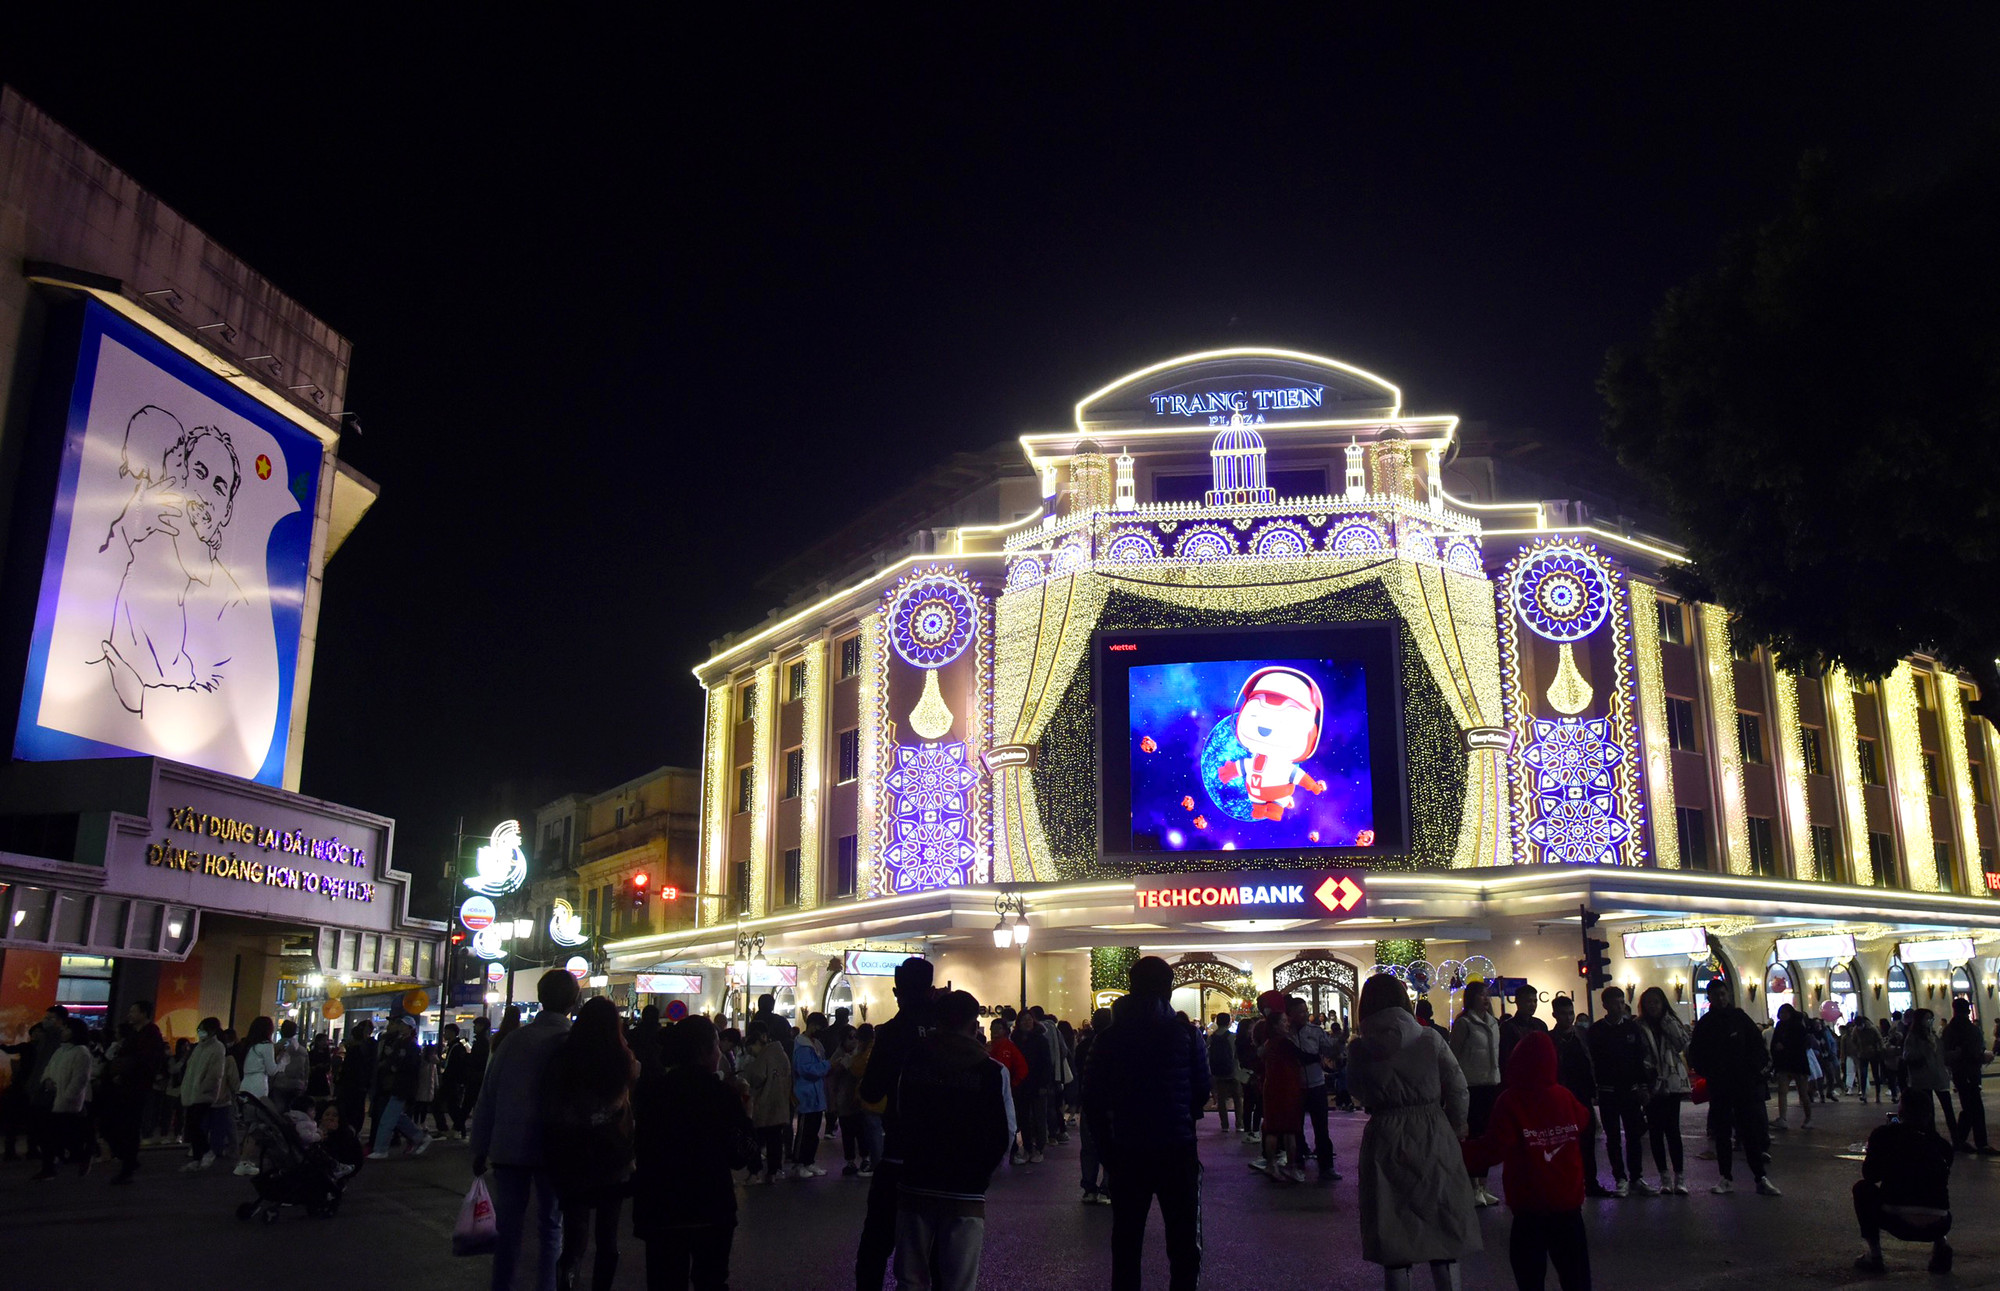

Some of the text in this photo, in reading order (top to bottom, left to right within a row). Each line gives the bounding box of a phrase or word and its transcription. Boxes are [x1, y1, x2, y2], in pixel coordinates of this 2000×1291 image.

[1150, 387, 1323, 417] TRANG TIEN
[1209, 414, 1265, 427] PLZA
[1109, 643, 1137, 651] viettel
[170, 806, 208, 835] XÂY
[210, 815, 254, 845] DỰNG
[257, 826, 280, 852] LẠI
[351, 847, 367, 868] TA
[265, 864, 300, 890] HƠN
[301, 870, 320, 893] TO
[662, 887, 676, 899] 23
[1136, 885, 1304, 908] TECHCOMBANK
[1832, 980, 1851, 989] GUCCI
